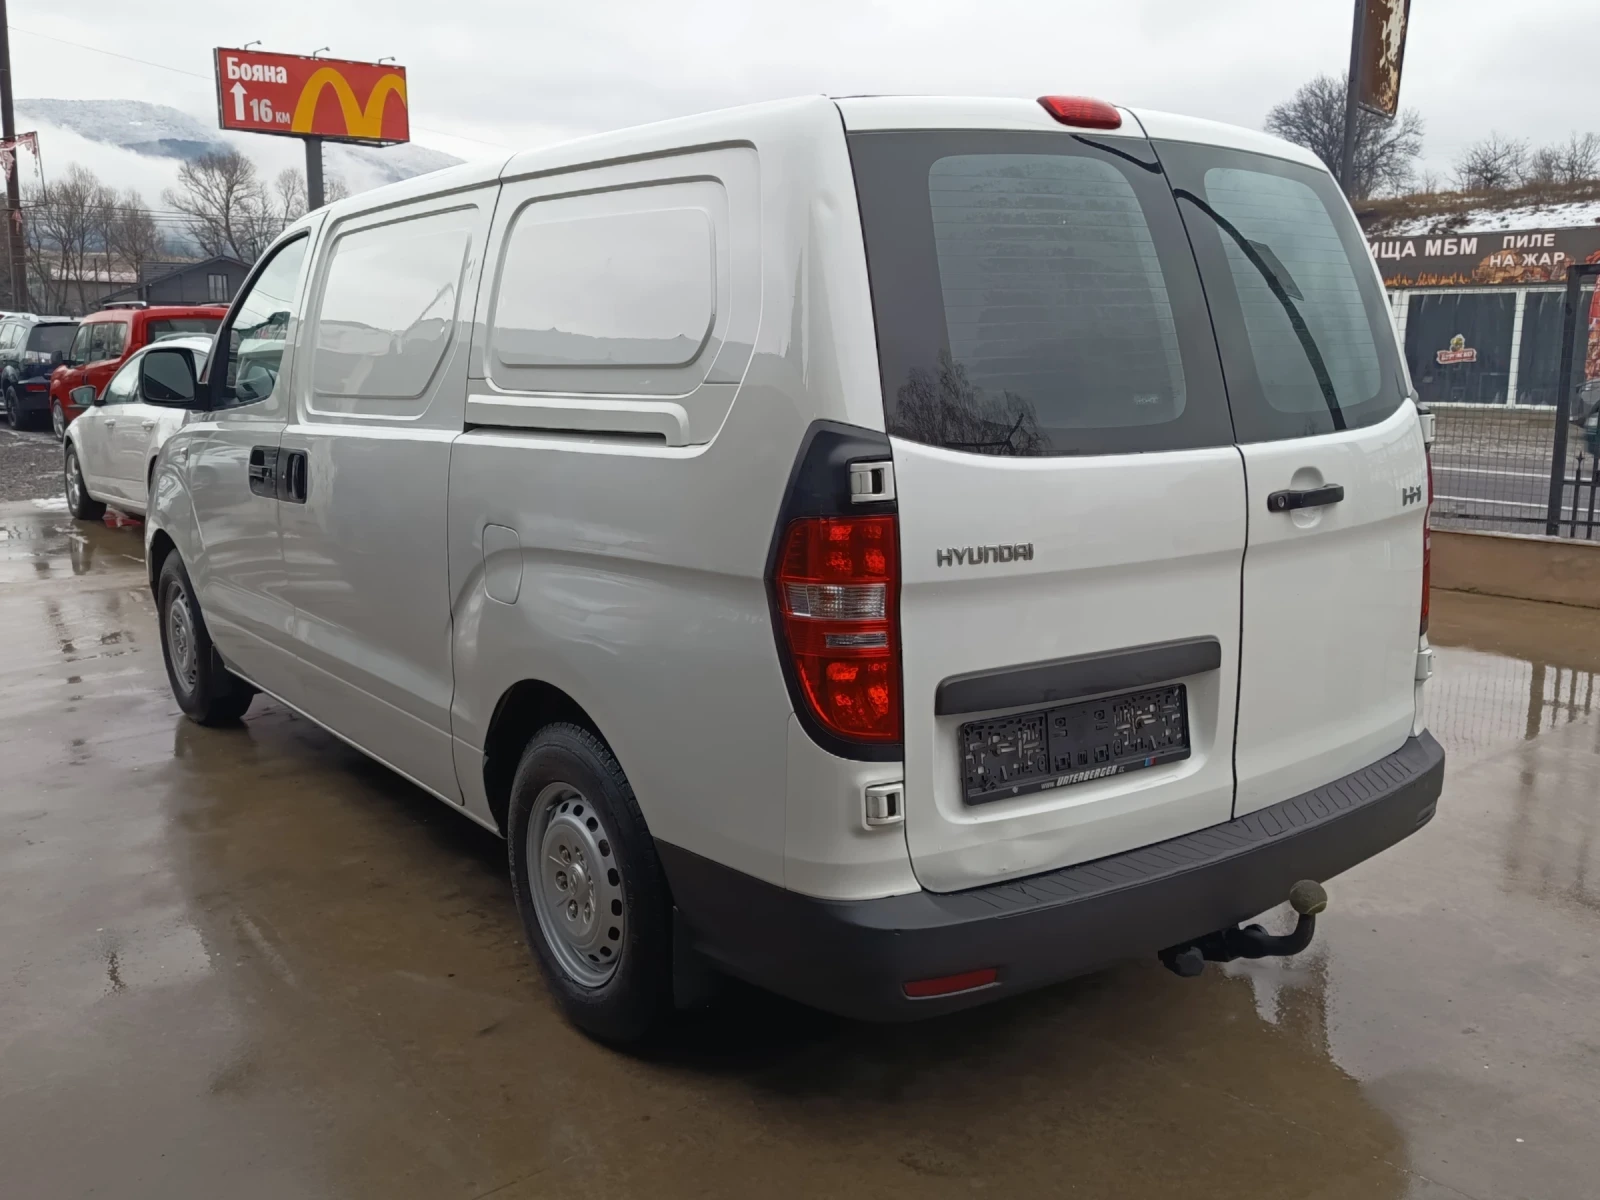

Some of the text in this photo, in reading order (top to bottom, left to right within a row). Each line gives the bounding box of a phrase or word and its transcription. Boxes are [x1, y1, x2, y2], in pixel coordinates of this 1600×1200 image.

[226, 57, 287, 84] Бояна
[249, 98, 273, 123] 16
[1425, 238, 1478, 256] МБМ
[1502, 233, 1555, 249] ПИЛЕ
[1489, 251, 1565, 267] НА ЖАР
[936, 542, 1034, 568] HYUNDAI
